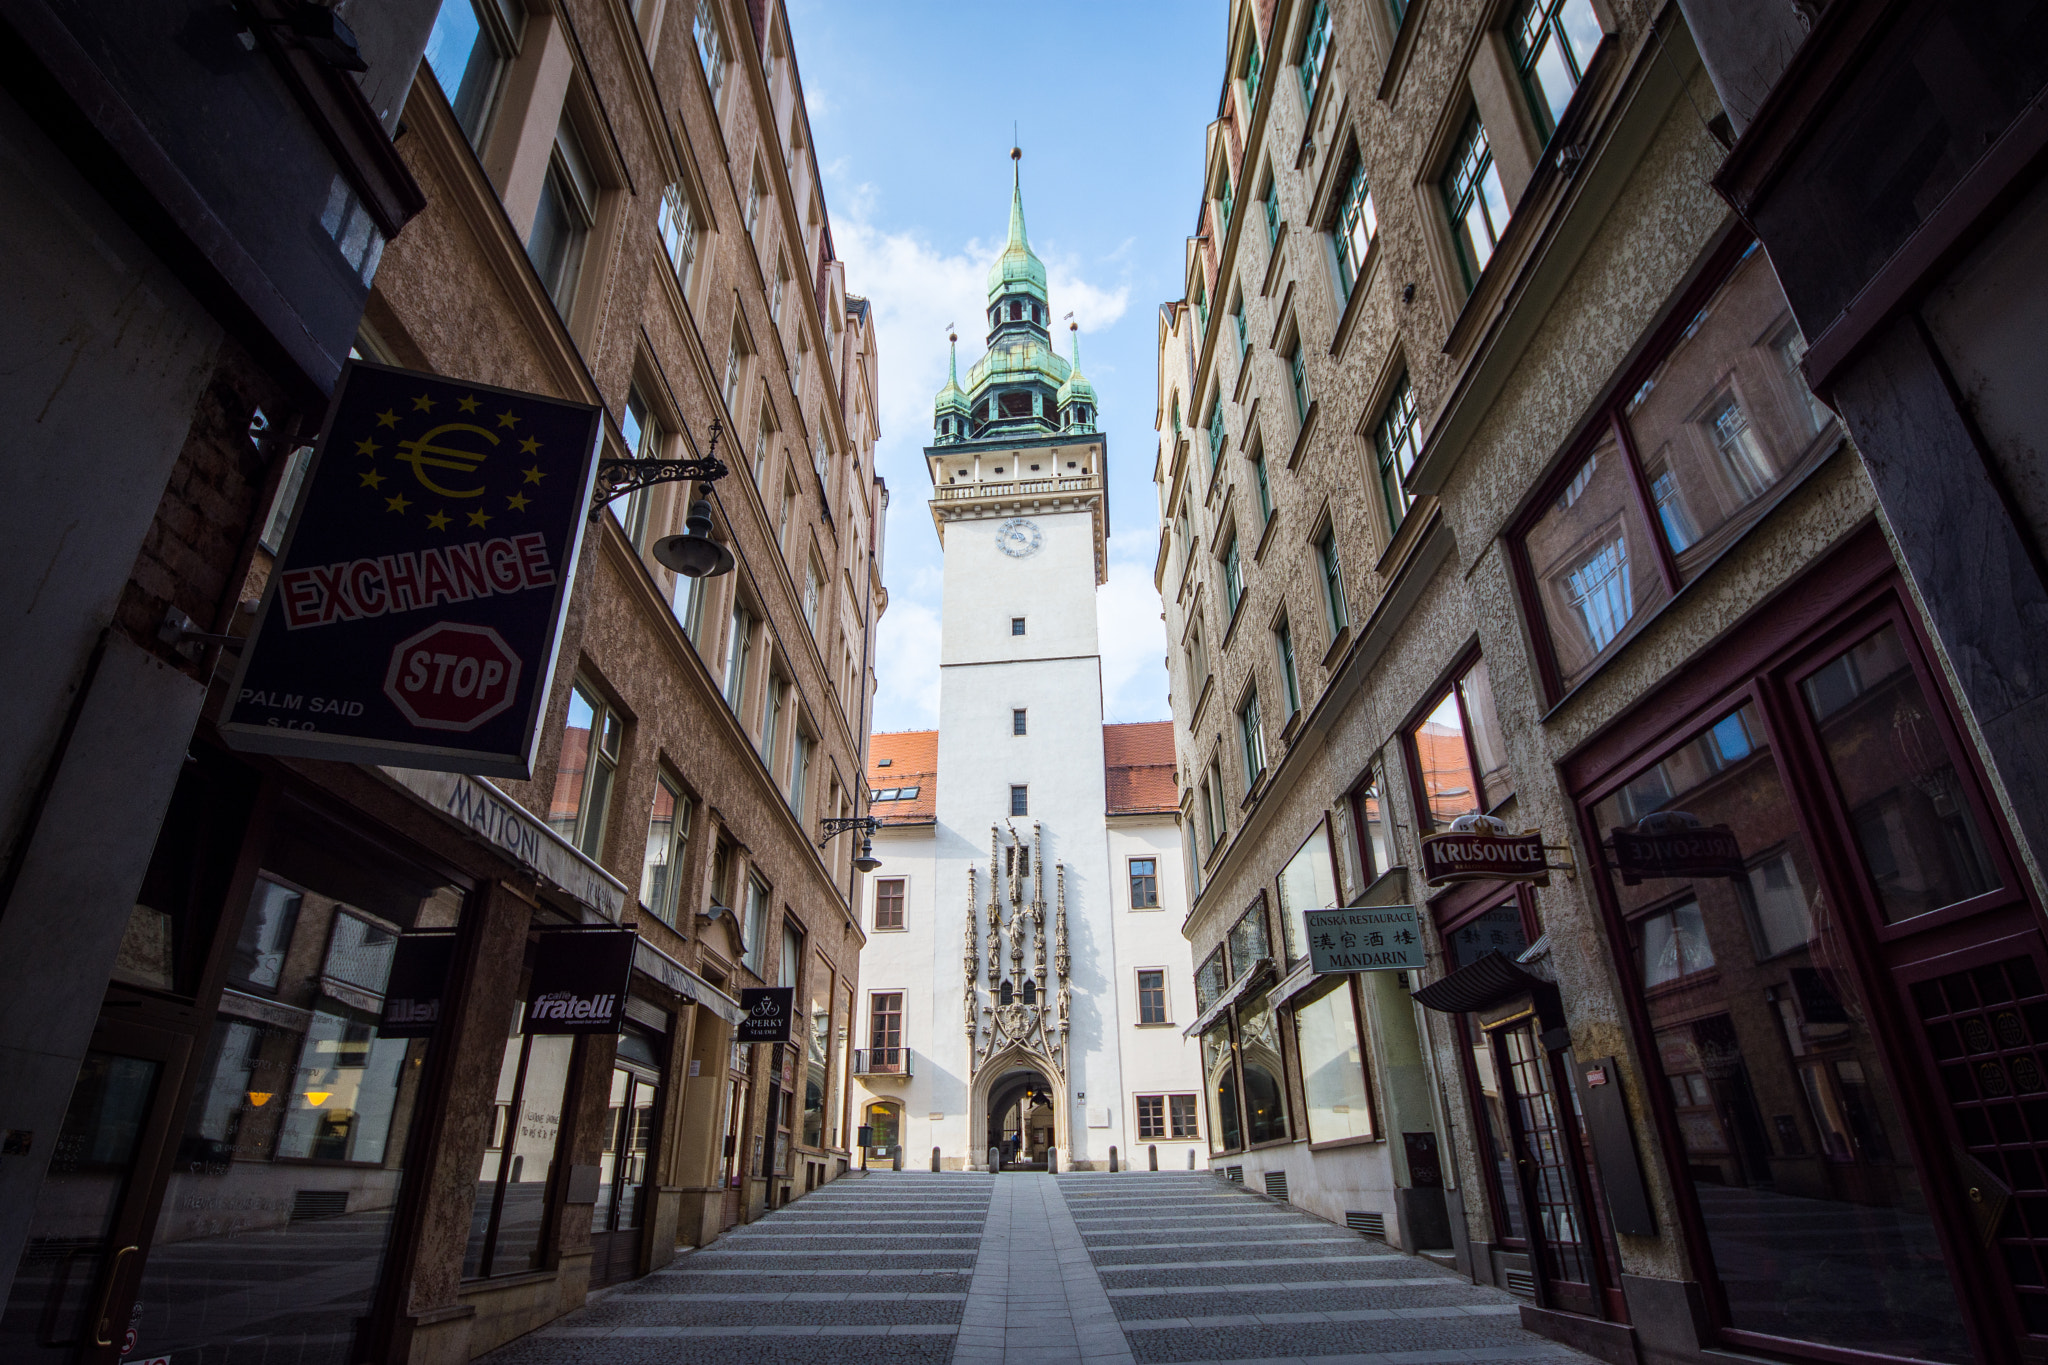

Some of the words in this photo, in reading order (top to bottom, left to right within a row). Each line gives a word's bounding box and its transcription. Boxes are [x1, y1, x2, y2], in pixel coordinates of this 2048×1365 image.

[279, 531, 557, 631] EXCHANGE
[403, 650, 505, 701] STOP
[236, 687, 304, 711] PALM
[308, 696, 365, 718] SAID
[446, 778, 541, 864] MATTONI
[1458, 824, 1470, 832] 15
[1493, 825, 1505, 833] 81
[1431, 839, 1542, 864] KRUŠOVICE
[1309, 913, 1347, 927] ČÍNSKÁ
[1349, 911, 1415, 925] RESTAURACE
[1328, 951, 1408, 967] MANDARIN
[530, 993, 617, 1019] fratelli
[745, 1018, 784, 1028] ŠPERKY
